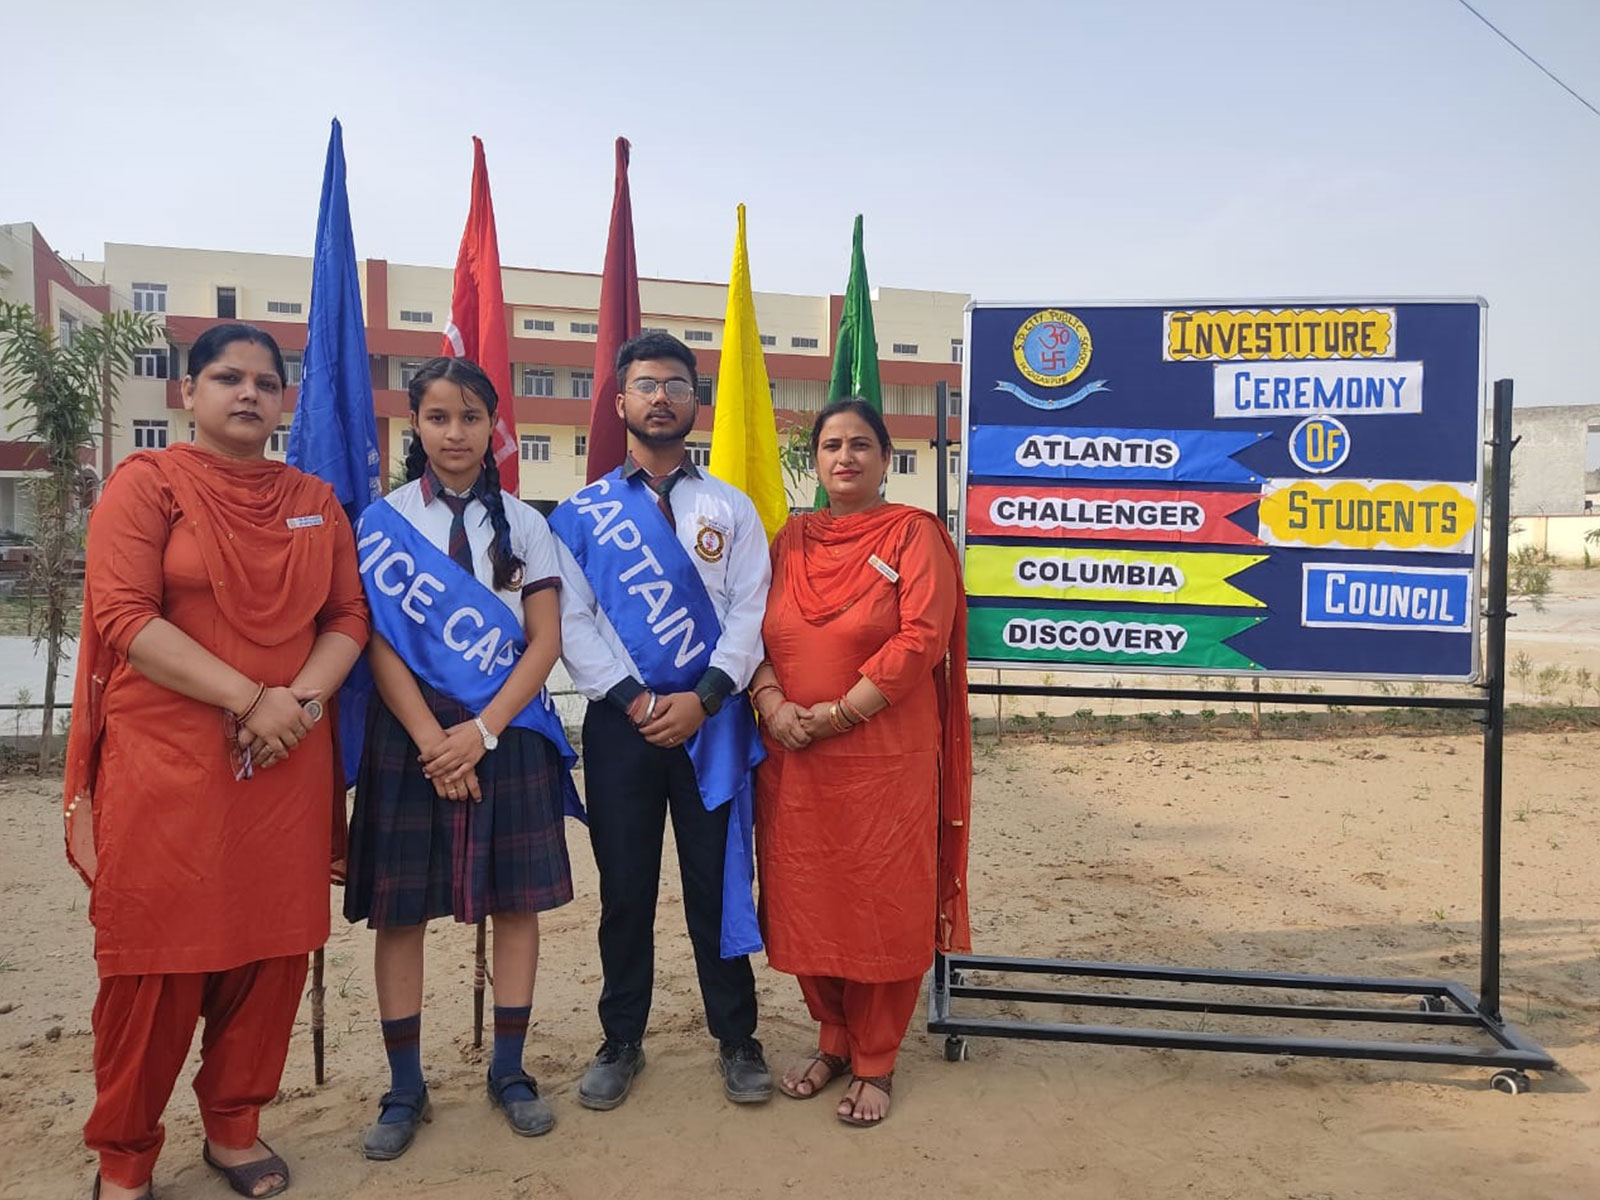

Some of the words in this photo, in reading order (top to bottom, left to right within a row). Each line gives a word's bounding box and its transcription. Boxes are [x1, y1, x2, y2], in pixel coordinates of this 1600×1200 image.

[1049, 311, 1084, 332] PUBLIC
[1076, 337, 1089, 369] SCHOOL
[1172, 315, 1377, 354] INVESTITURE
[1235, 371, 1406, 410] CEREMONY
[1023, 440, 1173, 463] ATLANTIS
[1306, 422, 1342, 462] OF
[998, 501, 1200, 525] CHALLENGER
[1288, 490, 1457, 533] STUDENTS
[357, 508, 446, 625] VICE
[443, 606, 522, 676] CAP
[570, 480, 706, 668] CAPTAIN
[1019, 561, 1178, 585] COLUMBIA
[1325, 573, 1454, 620] COUNCIL
[1008, 624, 1186, 651] DISCOVERY
